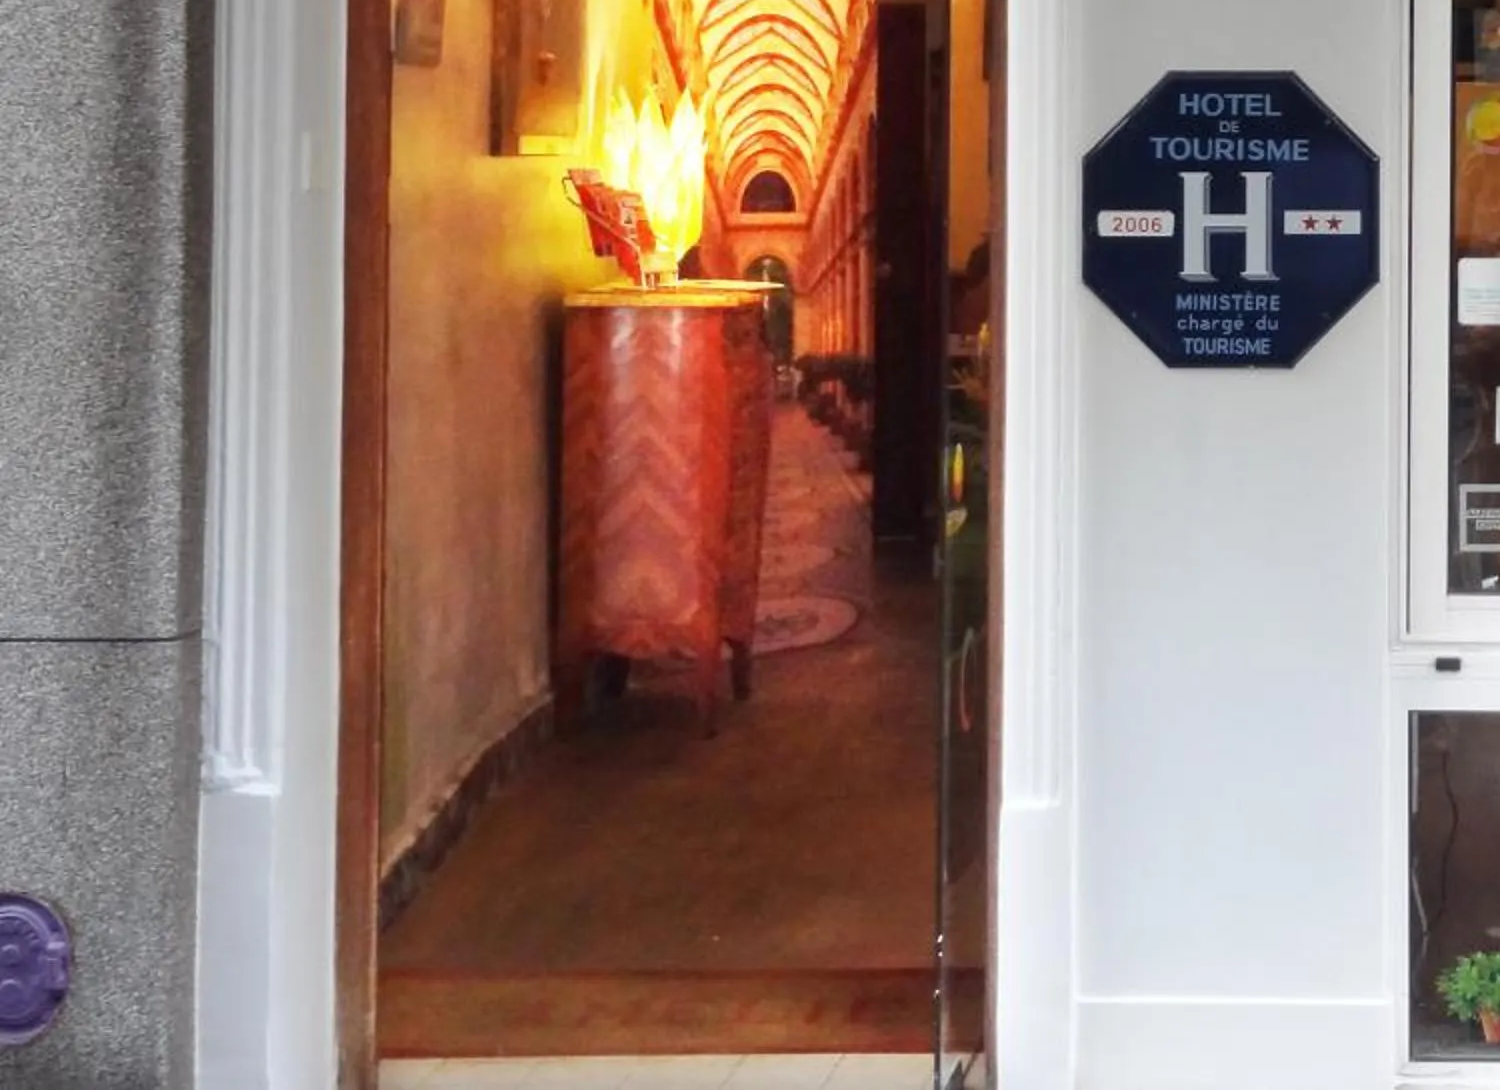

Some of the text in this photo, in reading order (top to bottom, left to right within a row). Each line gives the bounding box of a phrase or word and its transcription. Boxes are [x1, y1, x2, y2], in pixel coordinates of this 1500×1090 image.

[1178, 93, 1282, 117] HOTEL
[1218, 120, 1241, 133] DE
[1150, 137, 1310, 161] TOURISME
[1111, 216, 1163, 233] 2006
[1177, 170, 1280, 282] H
[1176, 290, 1281, 311] MINISTÈRE
[1176, 313, 1279, 335] chargé du
[1183, 337, 1272, 356] TOURISME
